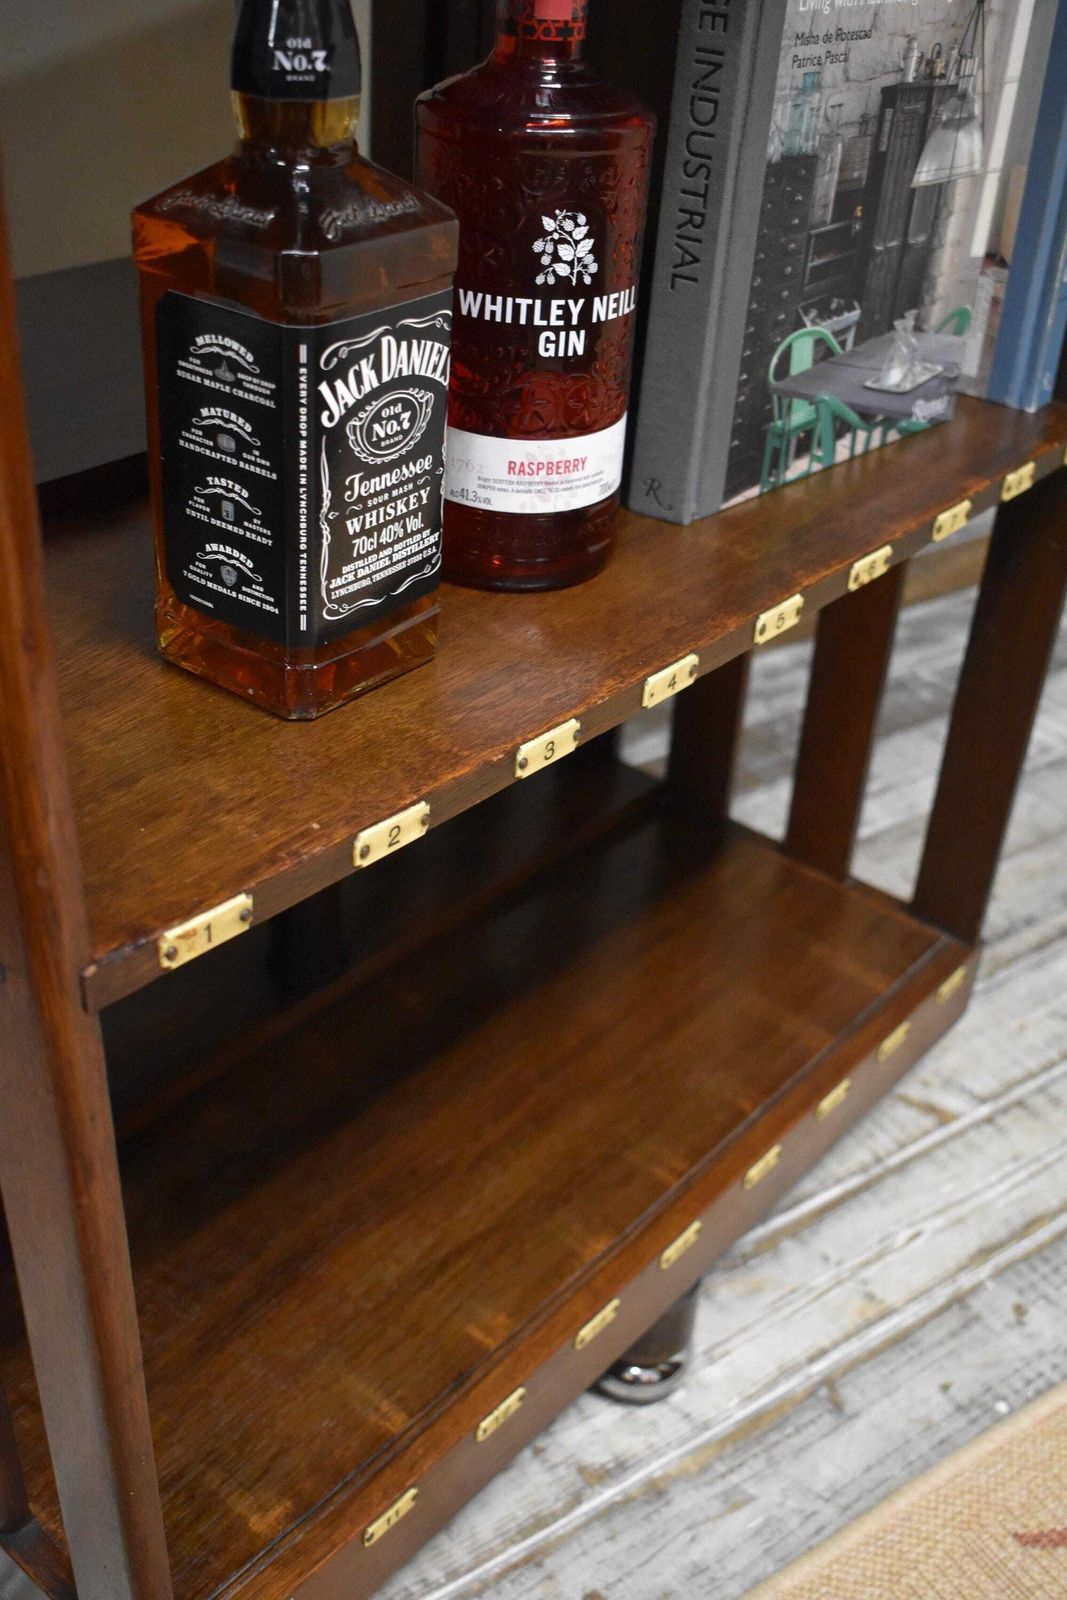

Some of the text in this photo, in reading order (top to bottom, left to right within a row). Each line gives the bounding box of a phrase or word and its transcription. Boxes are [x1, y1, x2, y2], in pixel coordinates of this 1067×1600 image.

[286, 37, 312, 49] Old
[794, 31, 820, 47] Misha
[822, 29, 834, 44] de
[791, 48, 851, 69] Patrice Pascal
[670, 0, 730, 290] E INDUSTRIAL
[458, 285, 636, 327] WHITLEY NEILL
[195, 334, 254, 363] MELLOWED
[538, 330, 586, 358] GIN
[176, 369, 276, 409] SUGAR MAPLE CHARCOAL
[317, 353, 380, 428] JACK
[200, 407, 252, 433] MATURED
[381, 402, 402, 418] Old
[380, 434, 404, 447] BRAND
[178, 438, 278, 480] HANDCRAFTED BARRELS
[507, 456, 588, 476] RASPBERRY
[206, 476, 249, 498] TASTED
[299, 367, 307, 611] EVERY DROP MADE IN LYNCHBURG TENNESSEE
[344, 454, 433, 502] Tennessee
[367, 482, 414, 508] SOUR MASH
[345, 486, 431, 536] WHISKEY
[185, 507, 273, 547] UNTIL DEEMED READY
[243, 521, 272, 536] MASTERS
[352, 511, 424, 558] 70cl 40% Vol.
[205, 543, 254, 569] AWARDED
[329, 571, 356, 589] JACK
[356, 557, 392, 579] DANIEL
[392, 531, 440, 563] DISTILLERY
[341, 554, 378, 575] DISTILLED
[378, 547, 393, 560] AND
[393, 533, 422, 553] BOTTLED
[422, 528, 431, 539] BY
[189, 564, 213, 579] QUALITY
[187, 573, 206, 585] GOLD
[206, 581, 237, 598] MEDALS
[238, 593, 262, 608] SINCE
[262, 603, 279, 615] 1904
[667, 673, 678, 690] 4
[544, 740, 555, 761] 3
[387, 825, 401, 848] 2
[204, 923, 212, 943] 1
